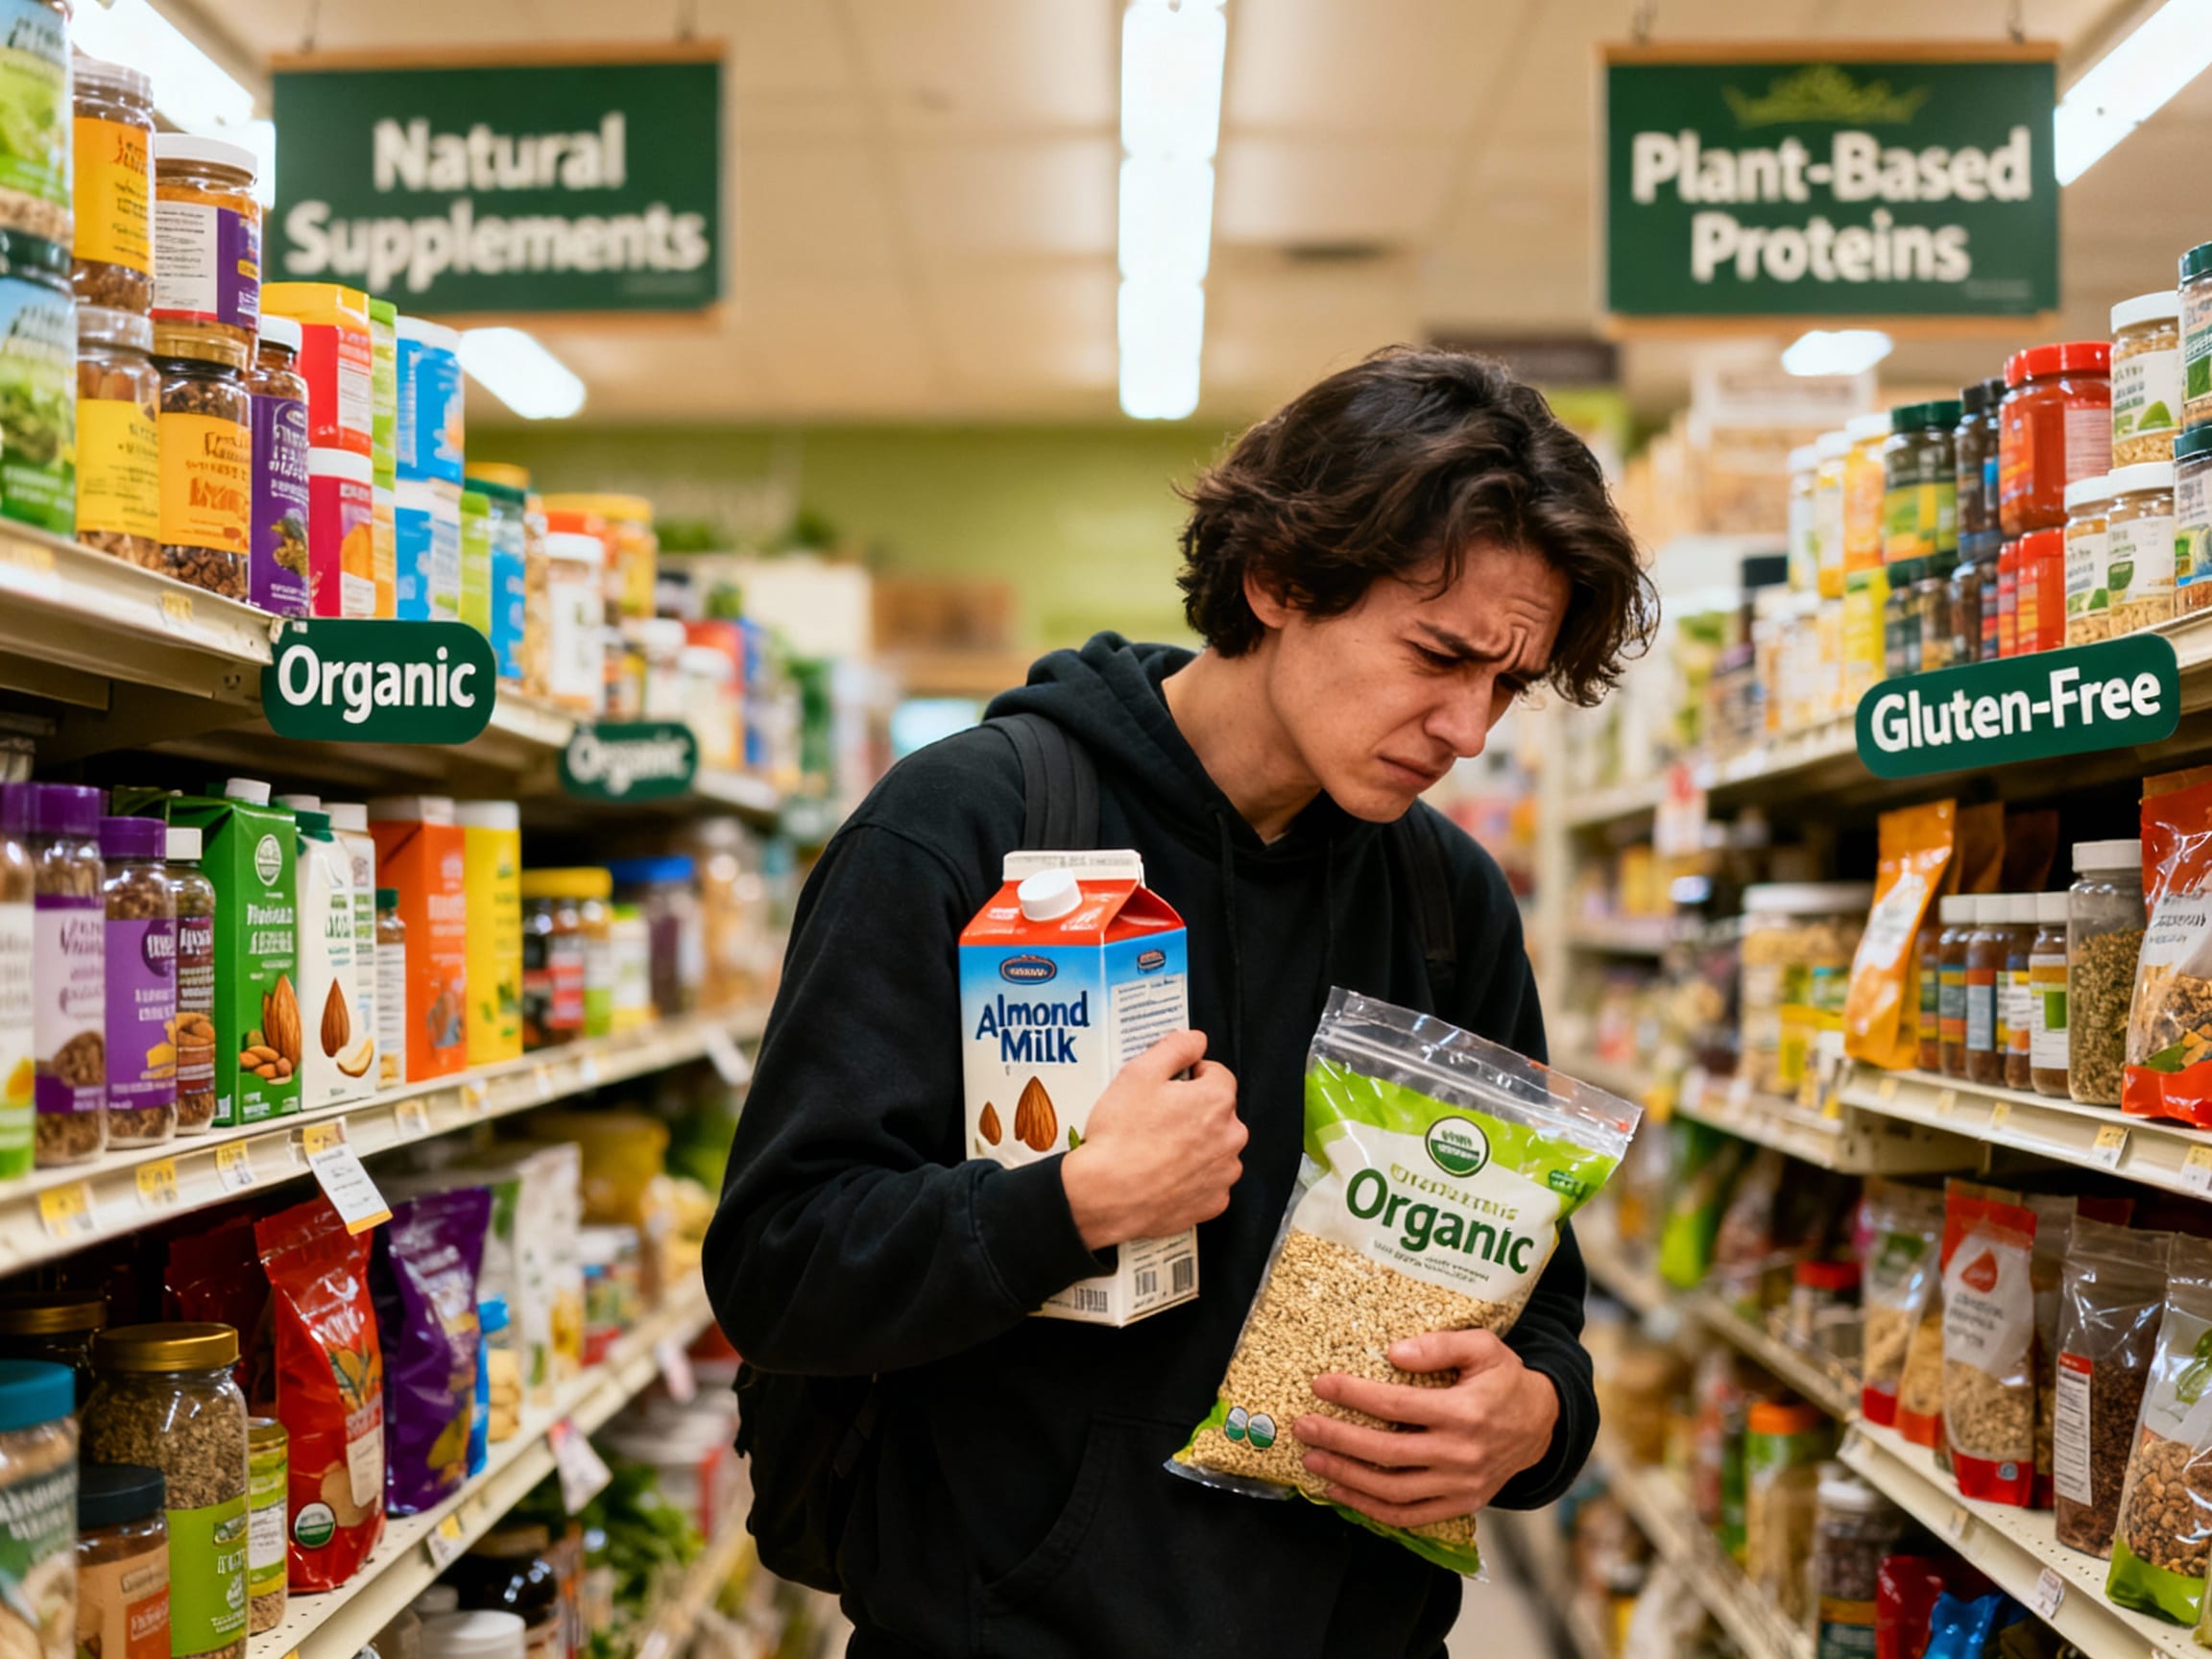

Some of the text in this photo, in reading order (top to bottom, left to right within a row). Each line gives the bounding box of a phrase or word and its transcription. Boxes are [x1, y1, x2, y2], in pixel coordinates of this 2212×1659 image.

[373, 110, 626, 192] Natural
[1632, 126, 2032, 204] Plant-Based
[284, 198, 709, 292] Supplements
[1691, 208, 1971, 282] Proteins
[277, 644, 476, 724] Organic
[1870, 666, 2161, 753] Gluten-Free
[566, 732, 689, 795] Organic
[975, 990, 1091, 1040] Almond
[1000, 1027, 1078, 1064] Milk
[1346, 1167, 1534, 1274] Organic
